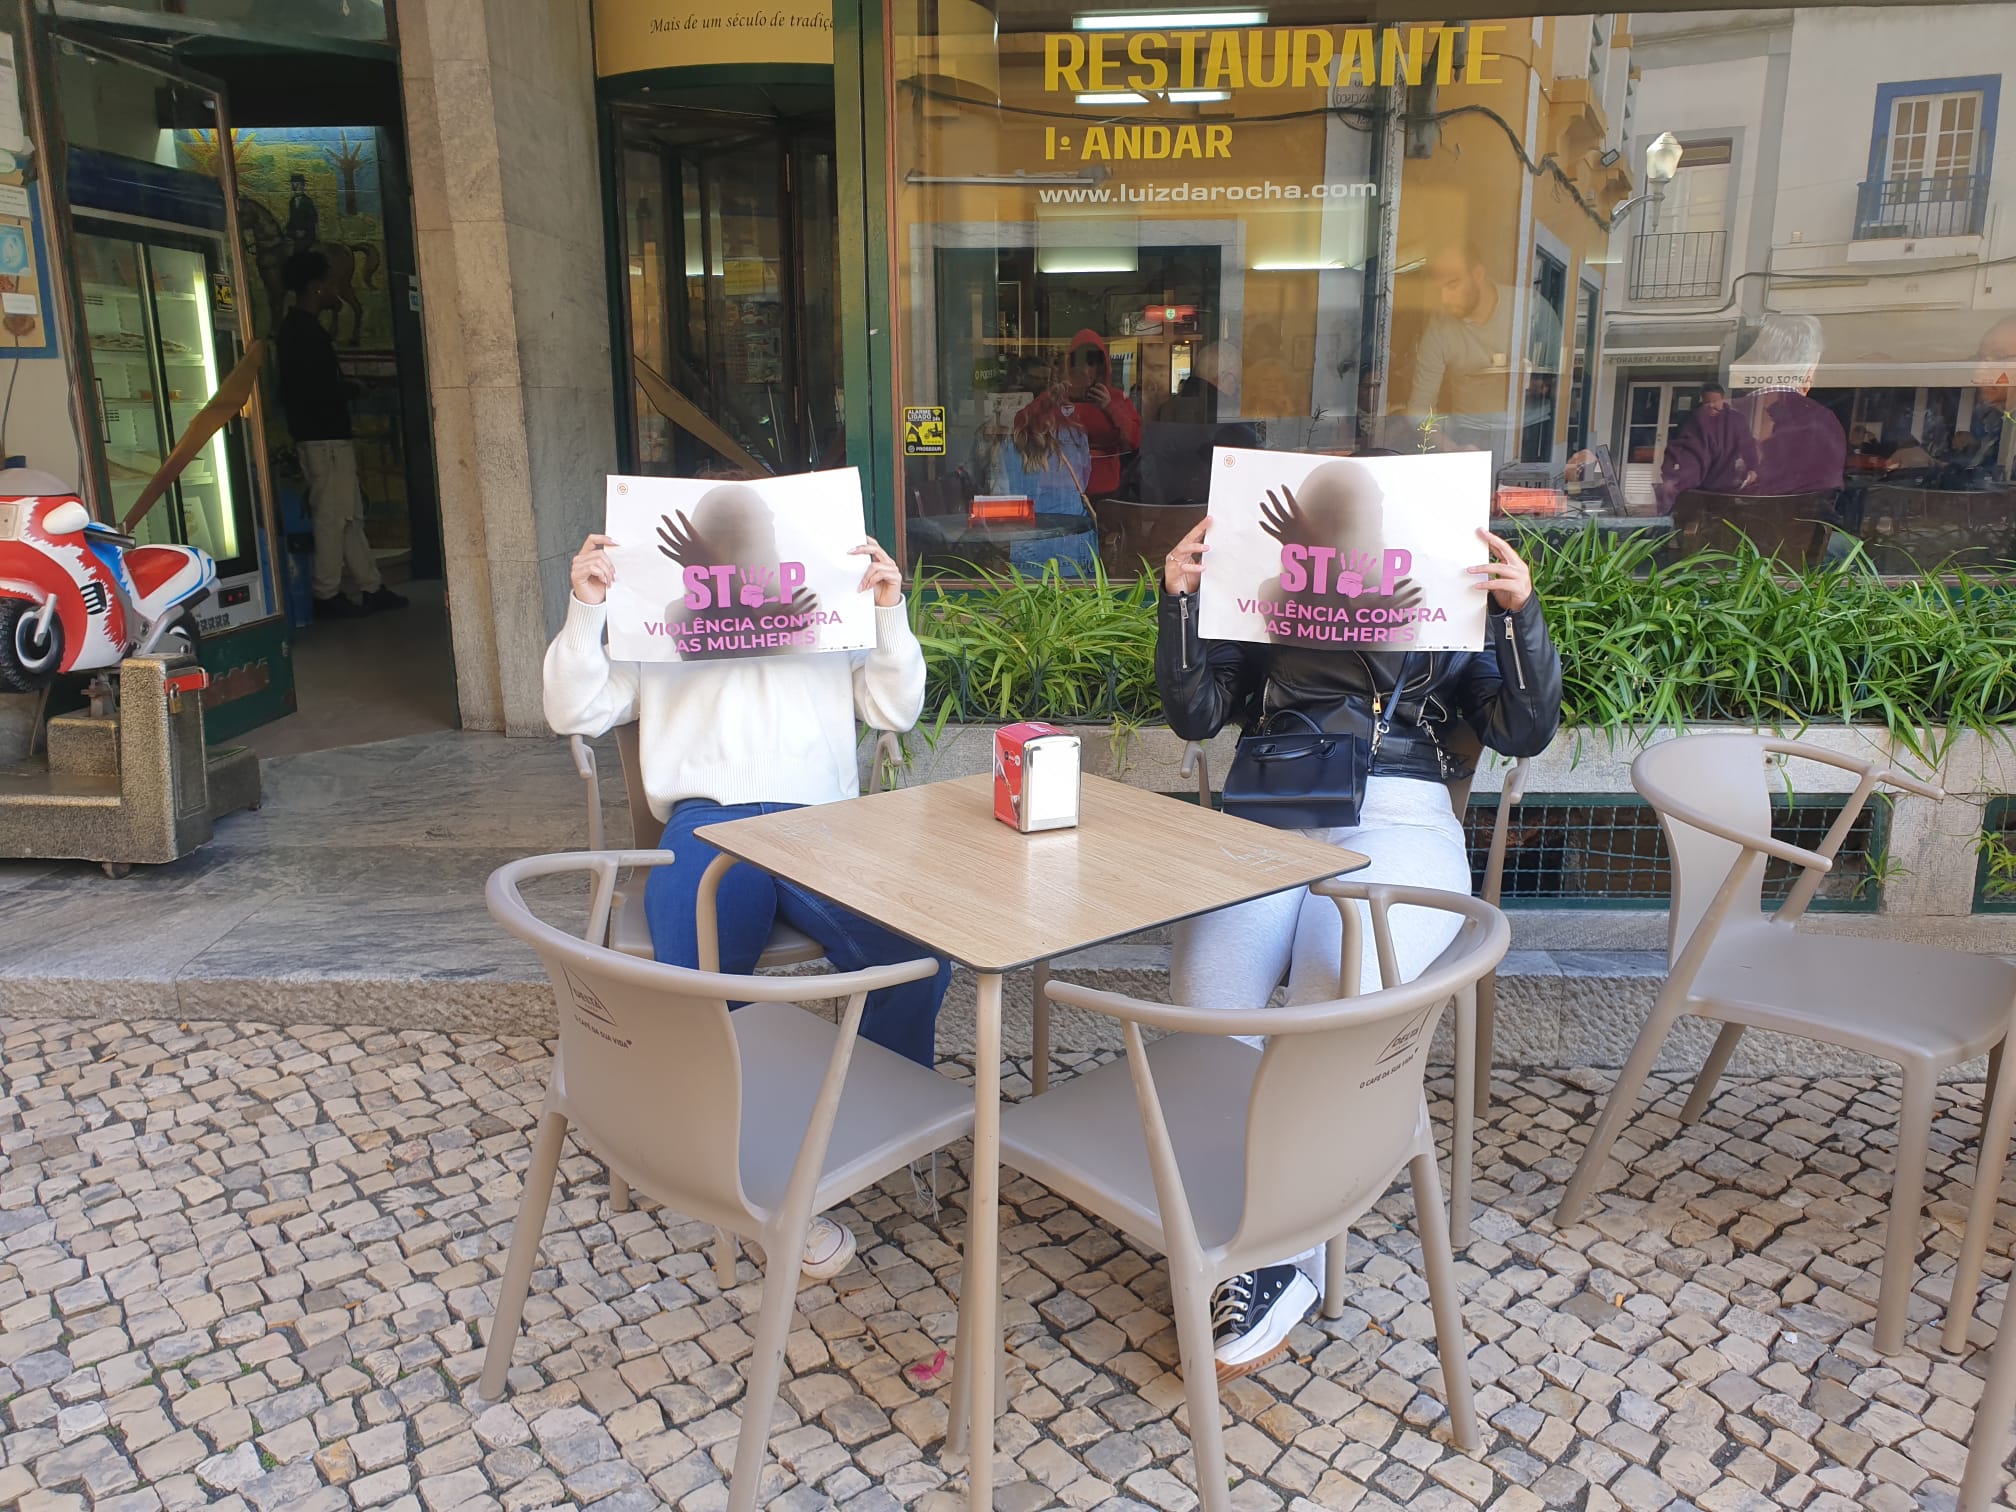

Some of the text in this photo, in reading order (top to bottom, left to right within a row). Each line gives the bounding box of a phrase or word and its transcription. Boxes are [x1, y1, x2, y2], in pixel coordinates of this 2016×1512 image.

[650, 16, 681, 34] Mais
[683, 13, 698, 31] de
[702, 17, 722, 29] um
[726, 10, 767, 28] século
[769, 10, 785, 28] de
[1043, 25, 1508, 92] RESTAURANTE
[1080, 124, 1234, 161] ANDAR
[1038, 180, 1379, 205] www.luizdarocha.com
[643, 610, 843, 637] VIOLÊNCIA CONTRA
[1236, 598, 1448, 625] VIOLÊNCIA CONTRA
[675, 637, 702, 654] AS
[706, 629, 818, 652] MULHERES
[1264, 620, 1416, 643] AS MULHERES
